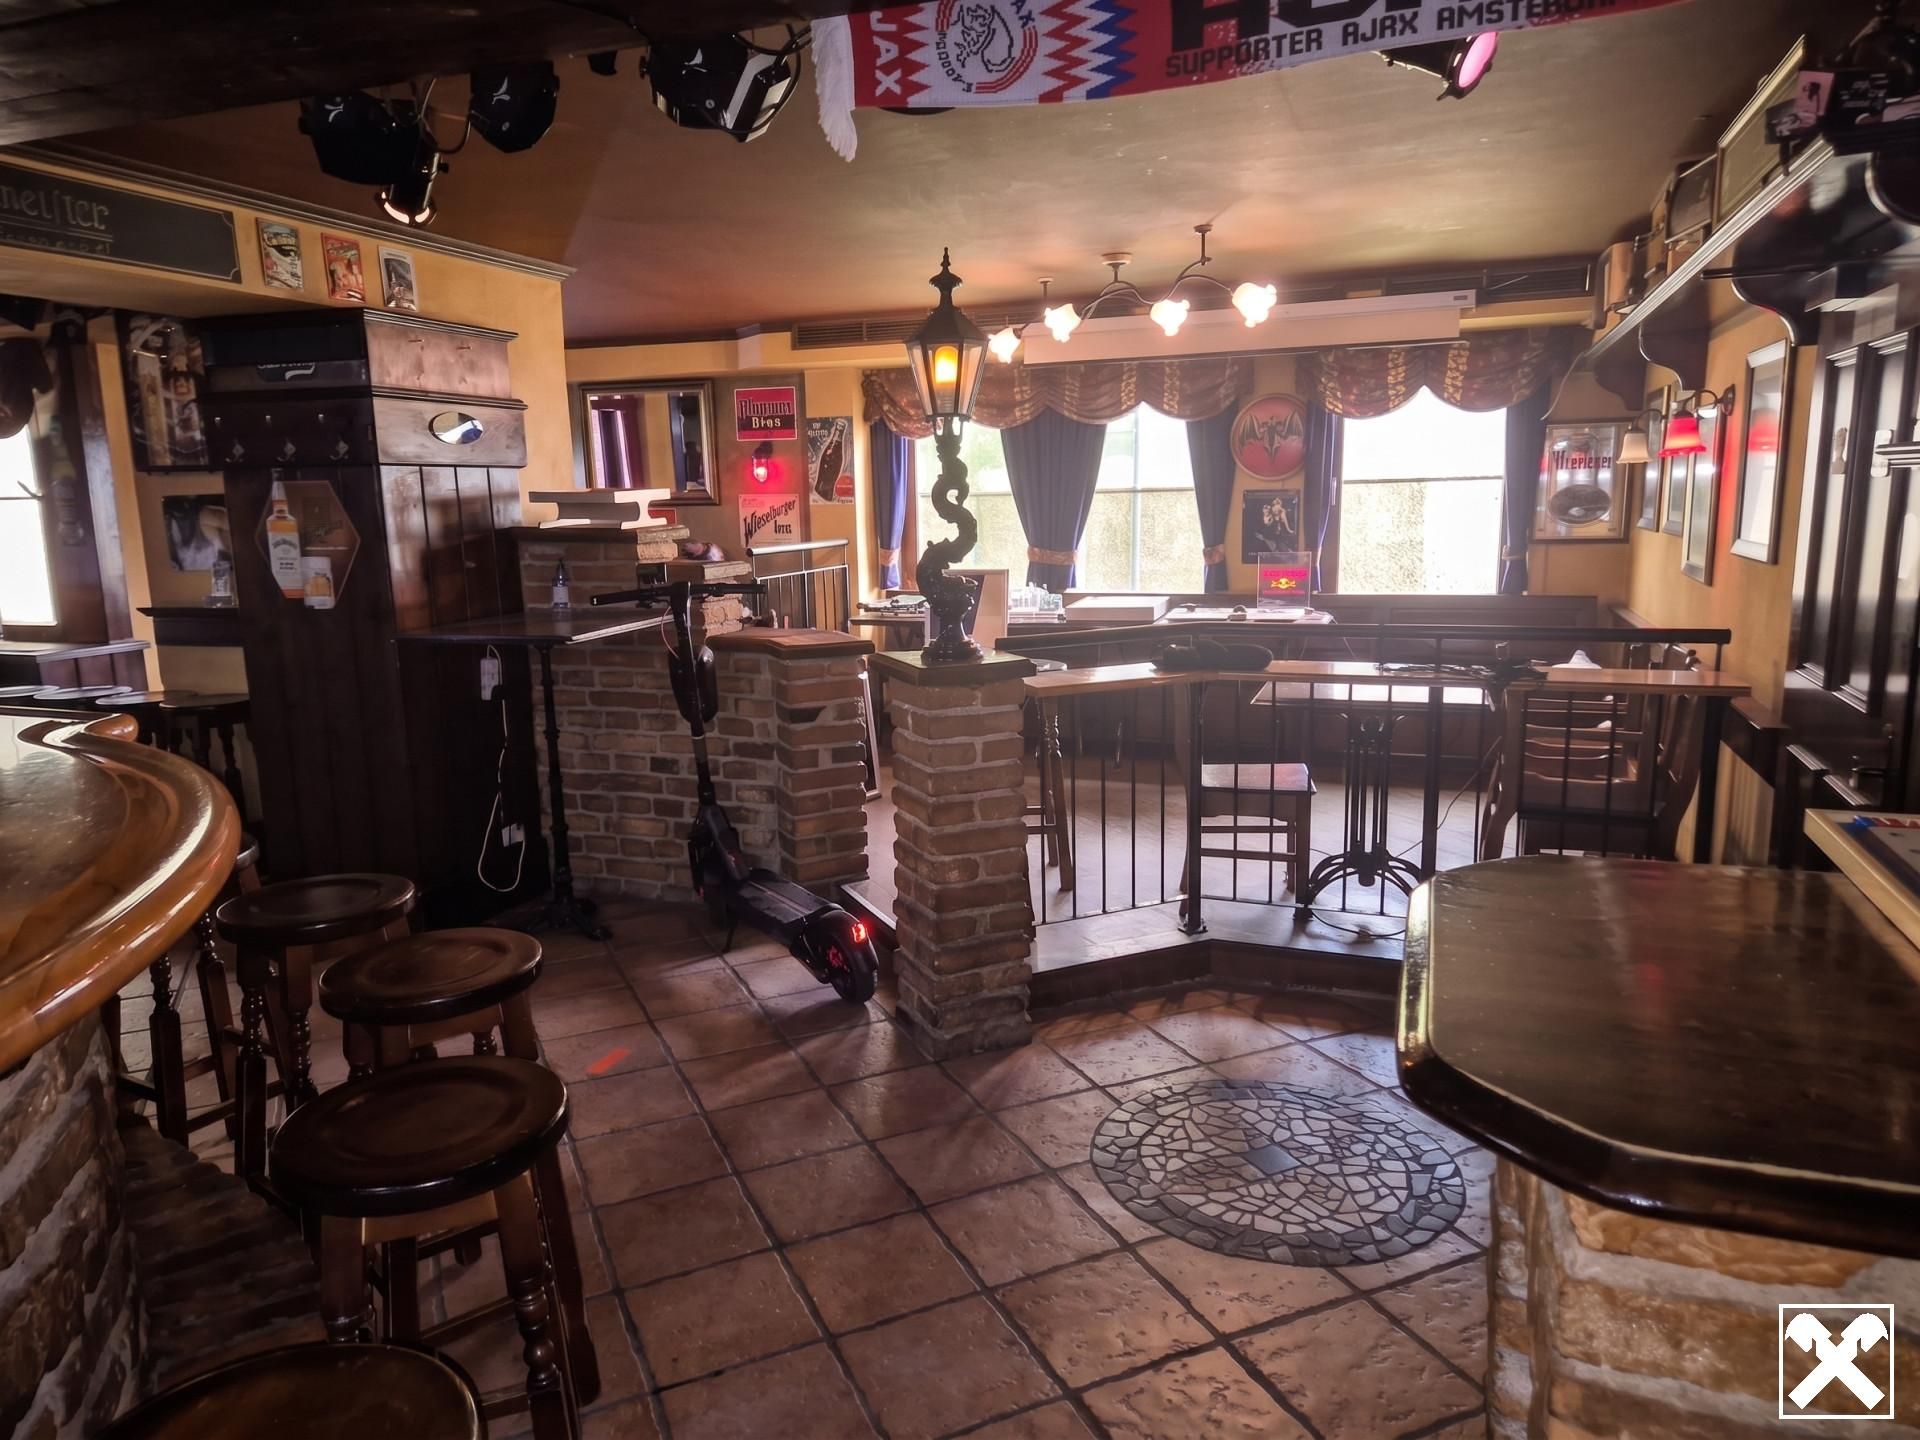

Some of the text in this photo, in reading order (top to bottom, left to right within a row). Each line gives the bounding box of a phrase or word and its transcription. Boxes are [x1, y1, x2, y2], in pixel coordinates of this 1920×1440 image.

[1166, 28, 1322, 78] SUPPORTER
[1342, 11, 1418, 46] AJAX
[743, 499, 796, 547] Wieselburger
